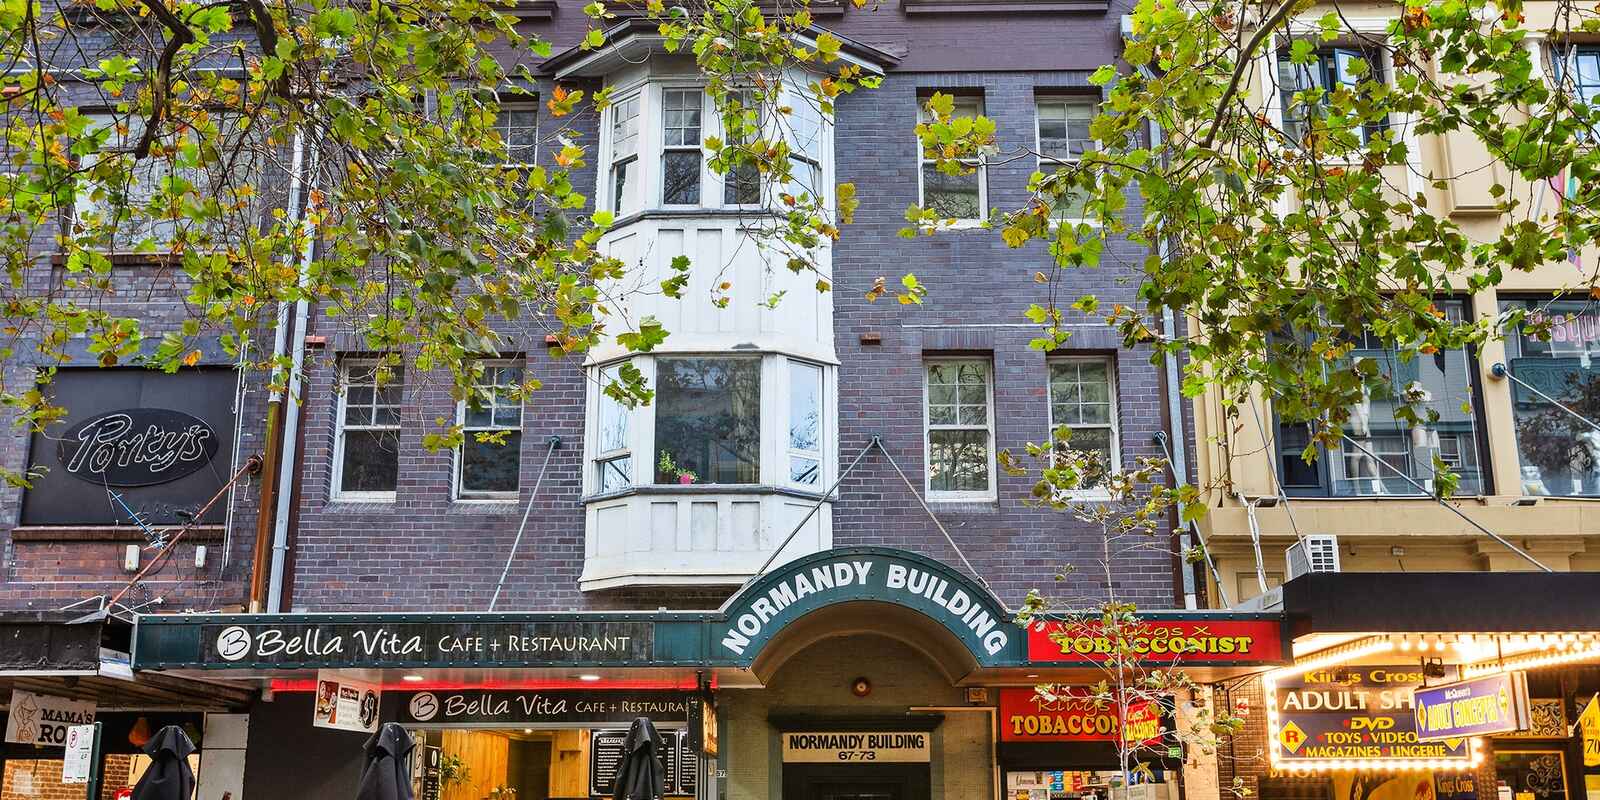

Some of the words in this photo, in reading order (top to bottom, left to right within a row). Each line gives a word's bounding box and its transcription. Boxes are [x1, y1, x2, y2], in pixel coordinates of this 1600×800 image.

[67, 413, 210, 473] Porky's
[722, 562, 873, 655] NORMANDY
[886, 564, 1008, 656] BUILDING
[255, 628, 343, 656] Bella
[353, 628, 422, 656] Vita
[438, 635, 482, 653] CAFE
[509, 635, 630, 653] RESTAURANT
[445, 694, 510, 717] Bella
[517, 694, 567, 716] Vita
[575, 700, 607, 713] CAFE
[1283, 691, 1369, 710] ADULT
[41, 709, 93, 724] MAMA'S
[1351, 716, 1395, 732] DVD
[38, 723, 68, 744] RO
[789, 734, 864, 750] NORMANDY
[868, 734, 924, 750] BUILDING
[1325, 732, 1361, 744] TOYS
[839, 751, 876, 761] 67-73
[1306, 745, 1381, 758] MAGAZINES
[1390, 745, 1446, 757] LINGERIE
